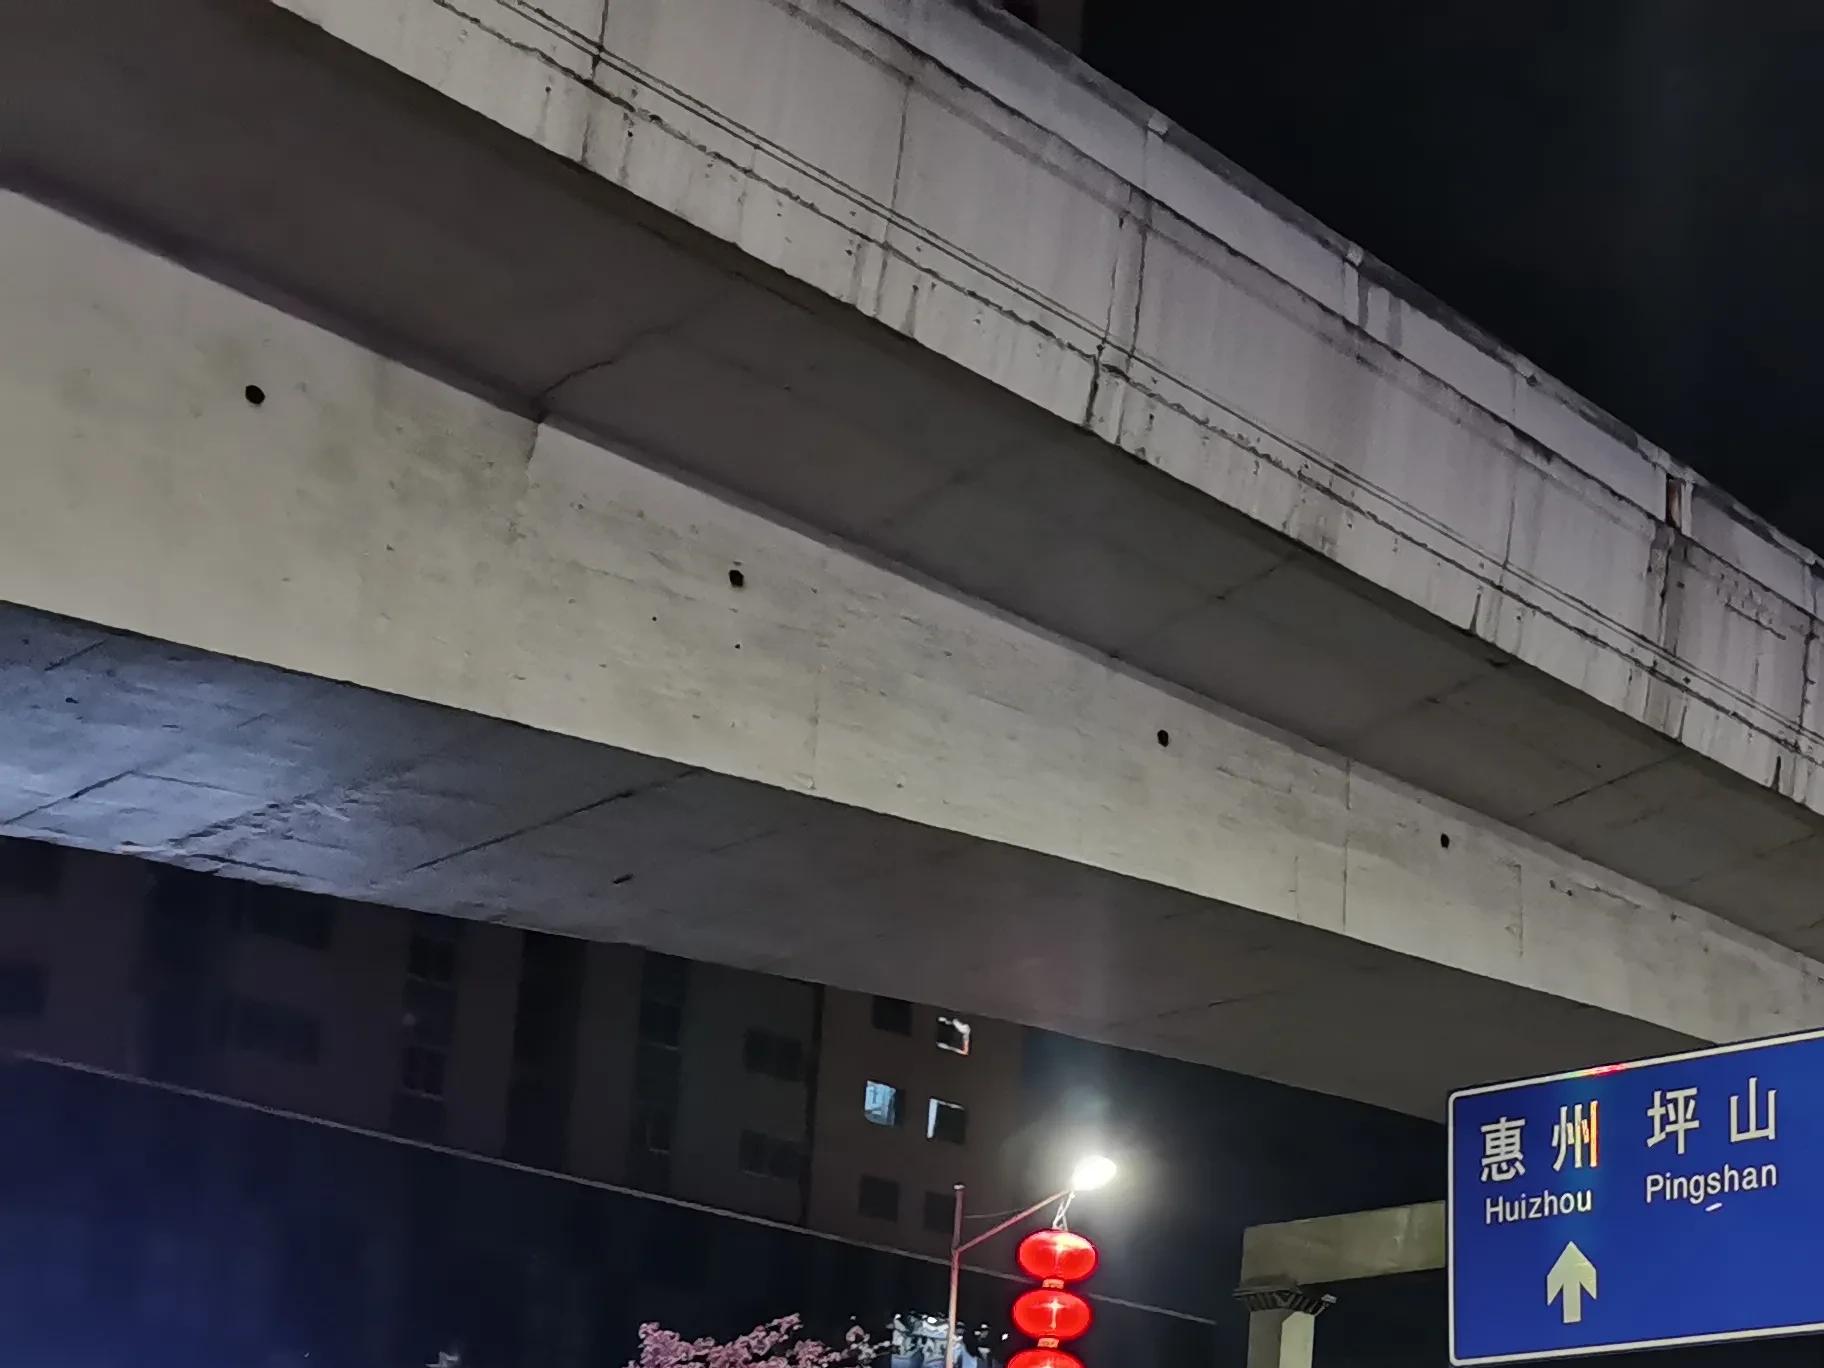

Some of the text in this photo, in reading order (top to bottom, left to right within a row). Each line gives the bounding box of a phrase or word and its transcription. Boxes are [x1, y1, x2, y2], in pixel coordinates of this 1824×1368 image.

[1480, 1100, 1600, 1183] 惠州
[1646, 1076, 1778, 1156] 坪山
[1485, 1188, 1593, 1225] Huizhou
[1646, 1162, 1778, 1206] Pingshan
